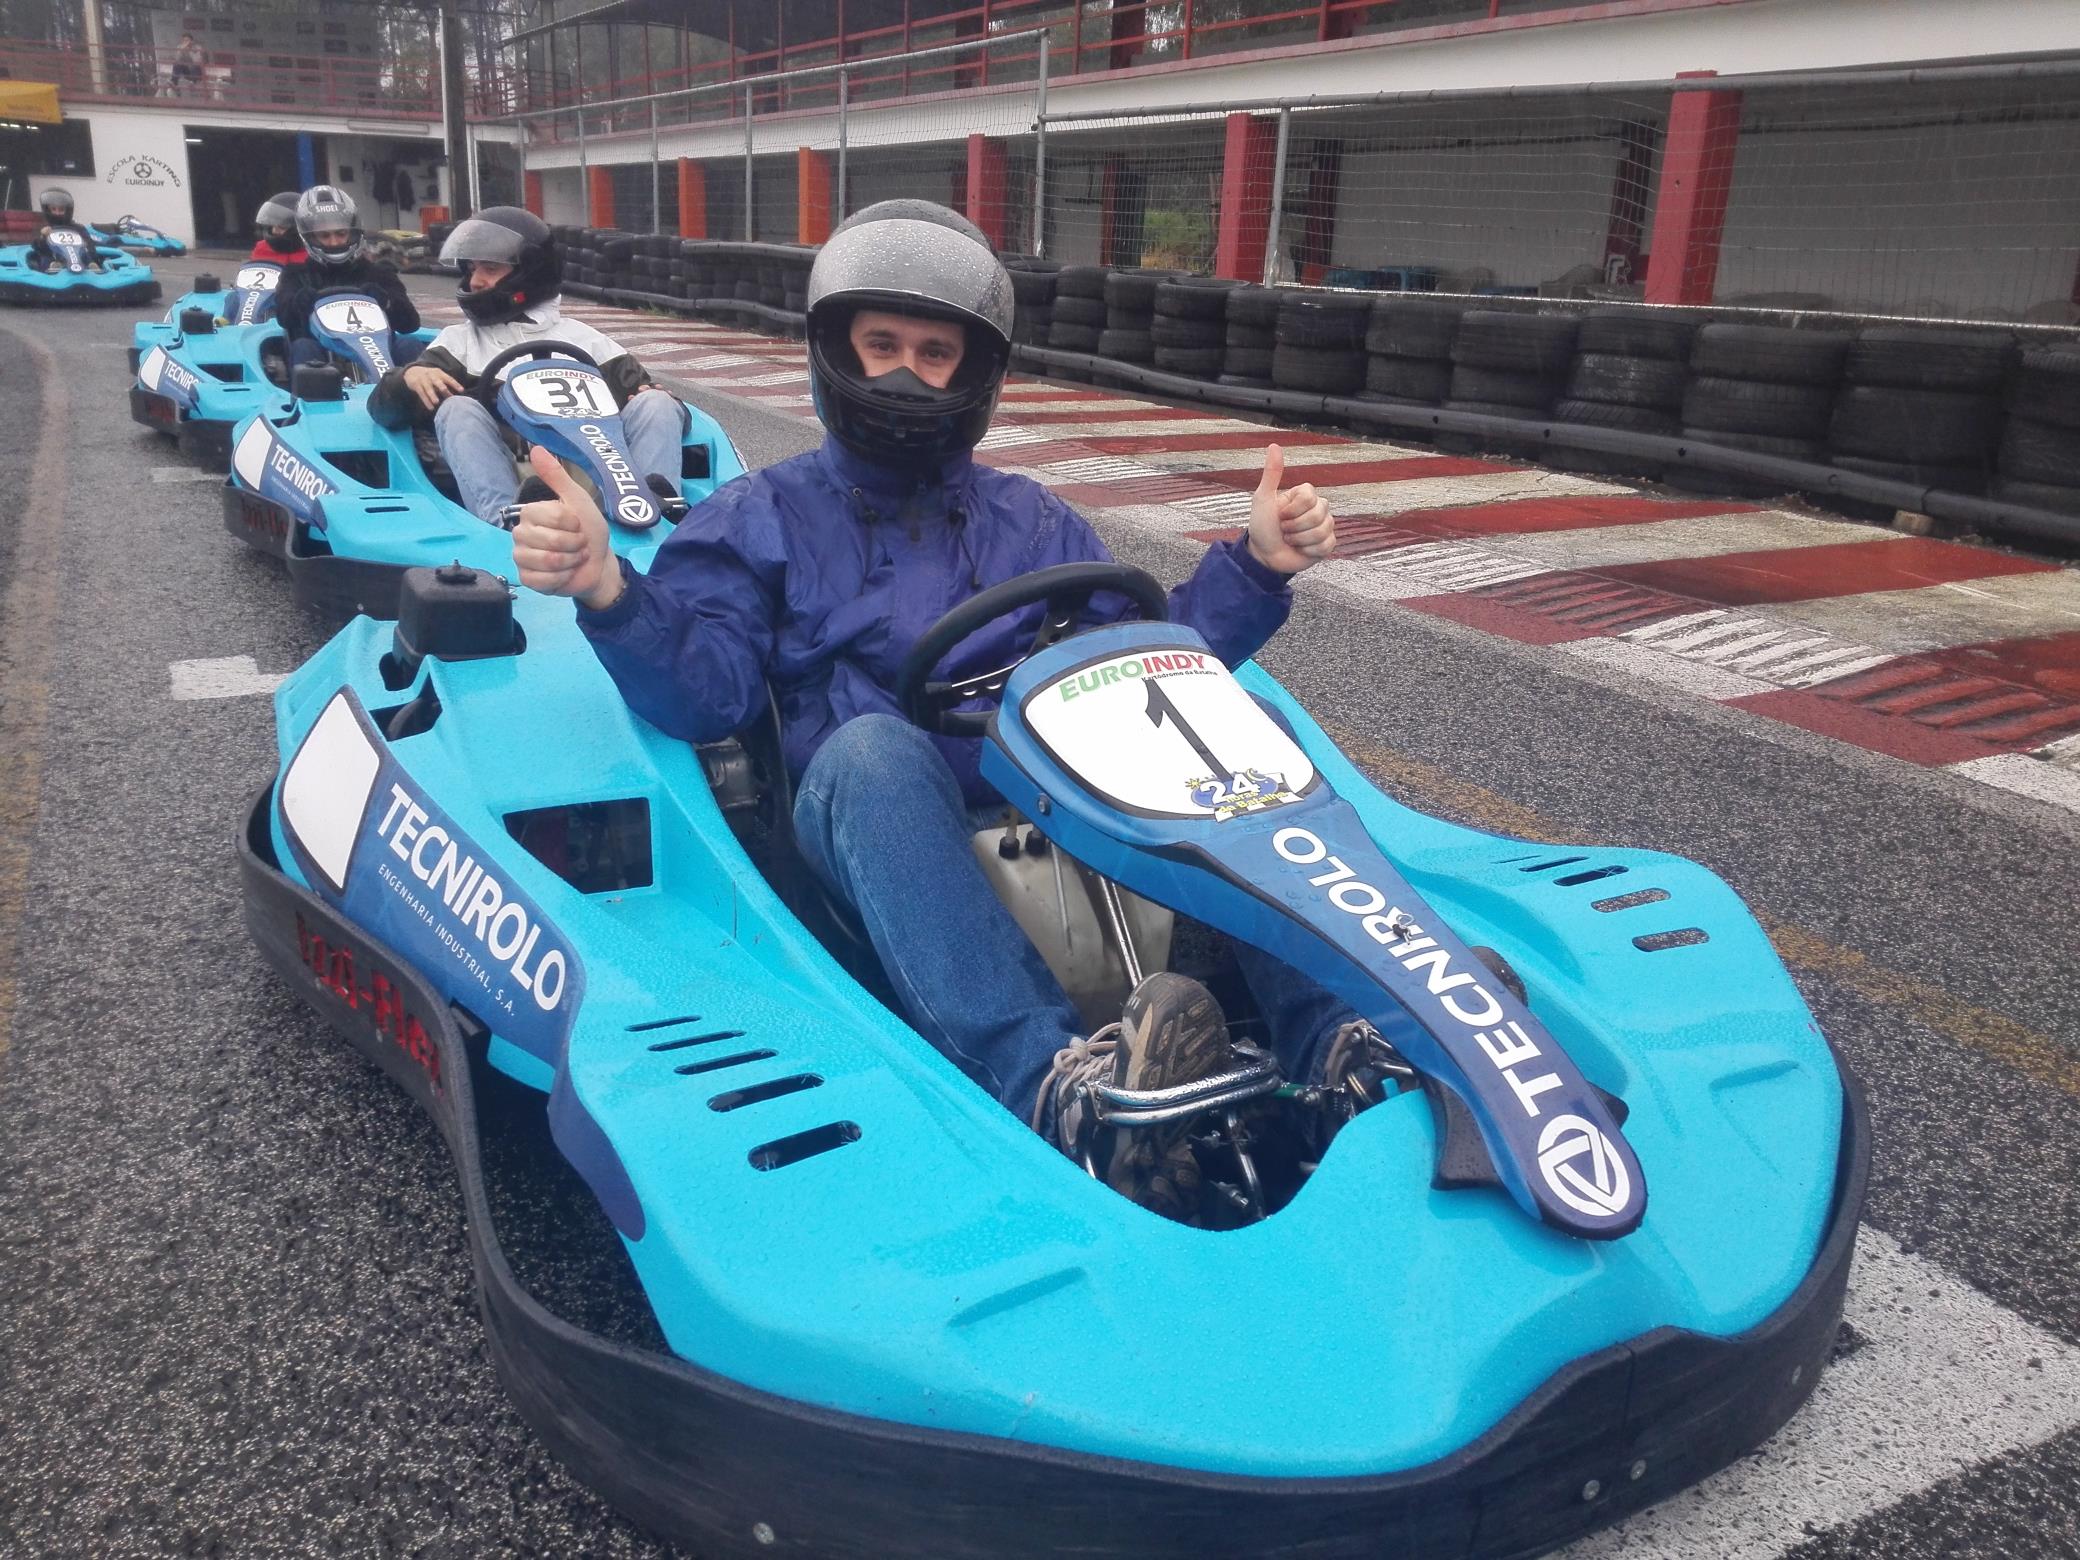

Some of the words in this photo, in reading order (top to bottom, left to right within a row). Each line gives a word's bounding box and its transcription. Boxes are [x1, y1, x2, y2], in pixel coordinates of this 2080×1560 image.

[106, 155, 136, 184] ESCOLA
[142, 155, 181, 188] KARTING
[315, 204, 338, 212] SHOEI
[59, 233, 74, 243] 23
[253, 271, 265, 287] 2
[346, 306, 362, 329] 4
[526, 370, 595, 381] EUROINDY
[540, 377, 599, 411] 31
[580, 424, 639, 495] TECNIROLO
[1059, 654, 1205, 702] EUROINDY
[1145, 677, 1236, 784] 1
[1200, 772, 1261, 805] 24
[377, 783, 566, 1011] TECNIROLO
[378, 863, 435, 928] ENGENHARIA
[436, 923, 493, 993] INDUSTRIAL,
[495, 988, 516, 1017] S.A.
[1272, 827, 1564, 1117] TECNIROLO
